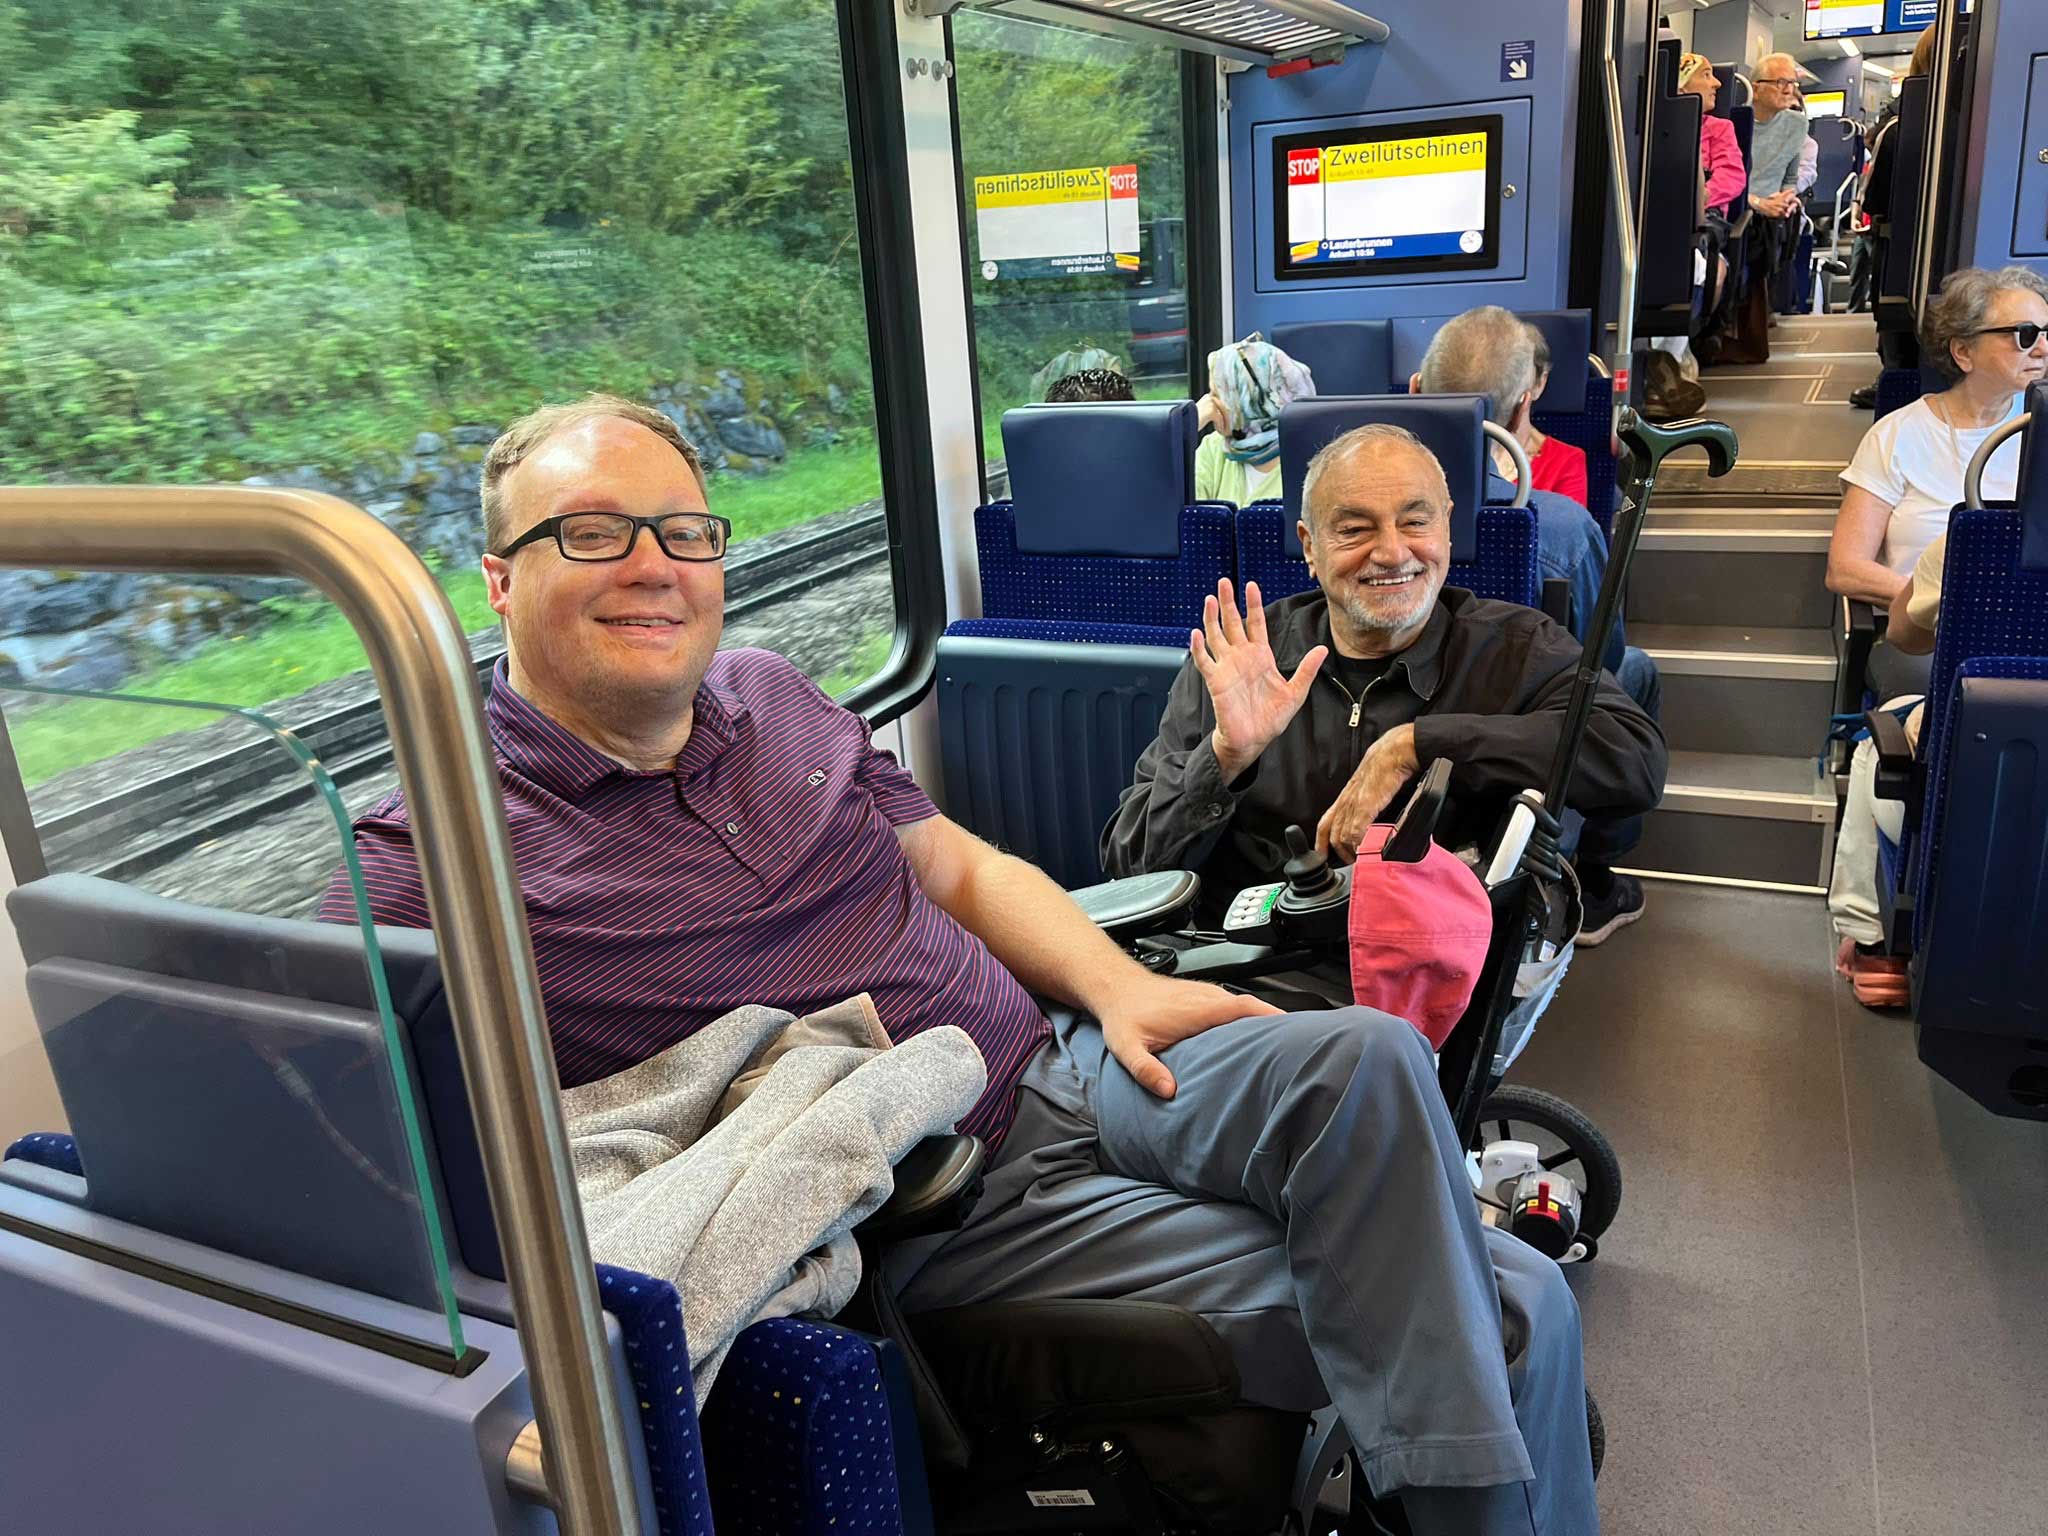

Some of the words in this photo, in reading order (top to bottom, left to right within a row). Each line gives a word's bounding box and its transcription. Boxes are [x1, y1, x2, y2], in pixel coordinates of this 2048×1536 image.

[1330, 139, 1483, 166] Zweilütschinen
[1288, 158, 1319, 176] STOP
[1329, 238, 1393, 250] Lauterbrunnen
